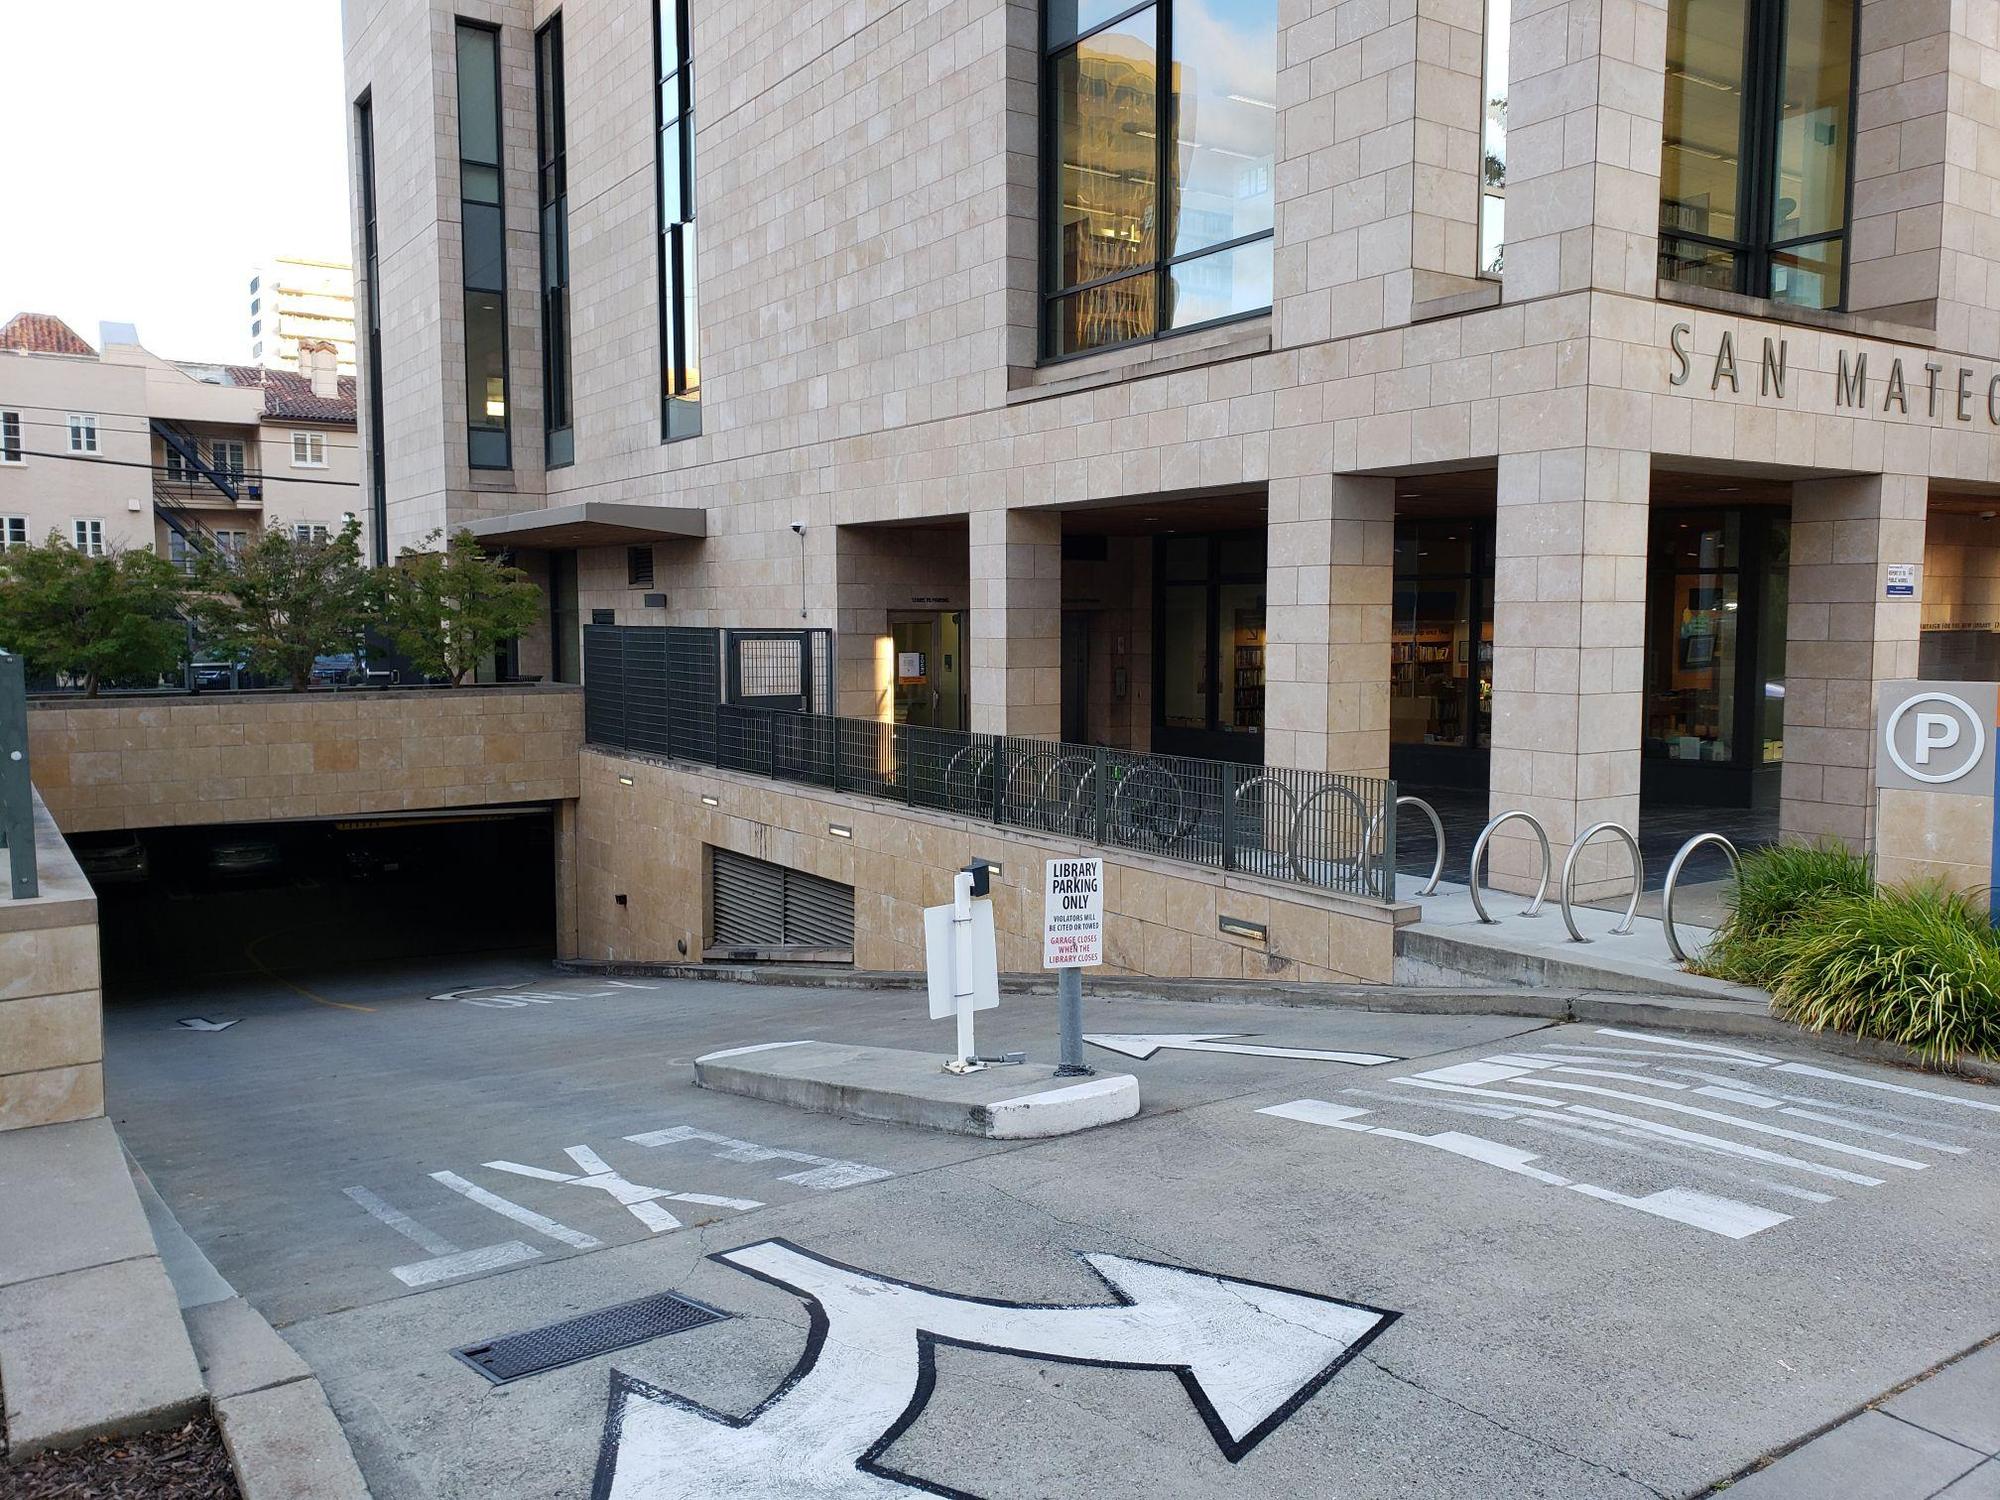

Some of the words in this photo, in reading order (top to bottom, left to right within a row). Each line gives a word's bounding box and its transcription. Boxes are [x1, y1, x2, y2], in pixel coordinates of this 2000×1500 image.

[1669, 322, 1788, 398] SAN
[1915, 712, 1960, 764] P
[1053, 862, 1097, 878] LIBRARY
[1052, 878, 1098, 894] PARKING
[1062, 894, 1089, 910] ONLY
[1053, 914, 1083, 922] VIOLATORS
[1057, 923, 1073, 931] CITED
[1074, 923, 1082, 931] OR
[1082, 922, 1099, 930] TOWED
[1050, 936, 1076, 944] GARAGE
[1077, 934, 1097, 943] CLOSES
[1058, 945, 1078, 953] WHEN
[1079, 944, 1090, 952] THE
[1049, 954, 1077, 963] LIBRARY
[1078, 953, 1098, 962] CLOSES
[342, 1125, 897, 1287] EXIT
